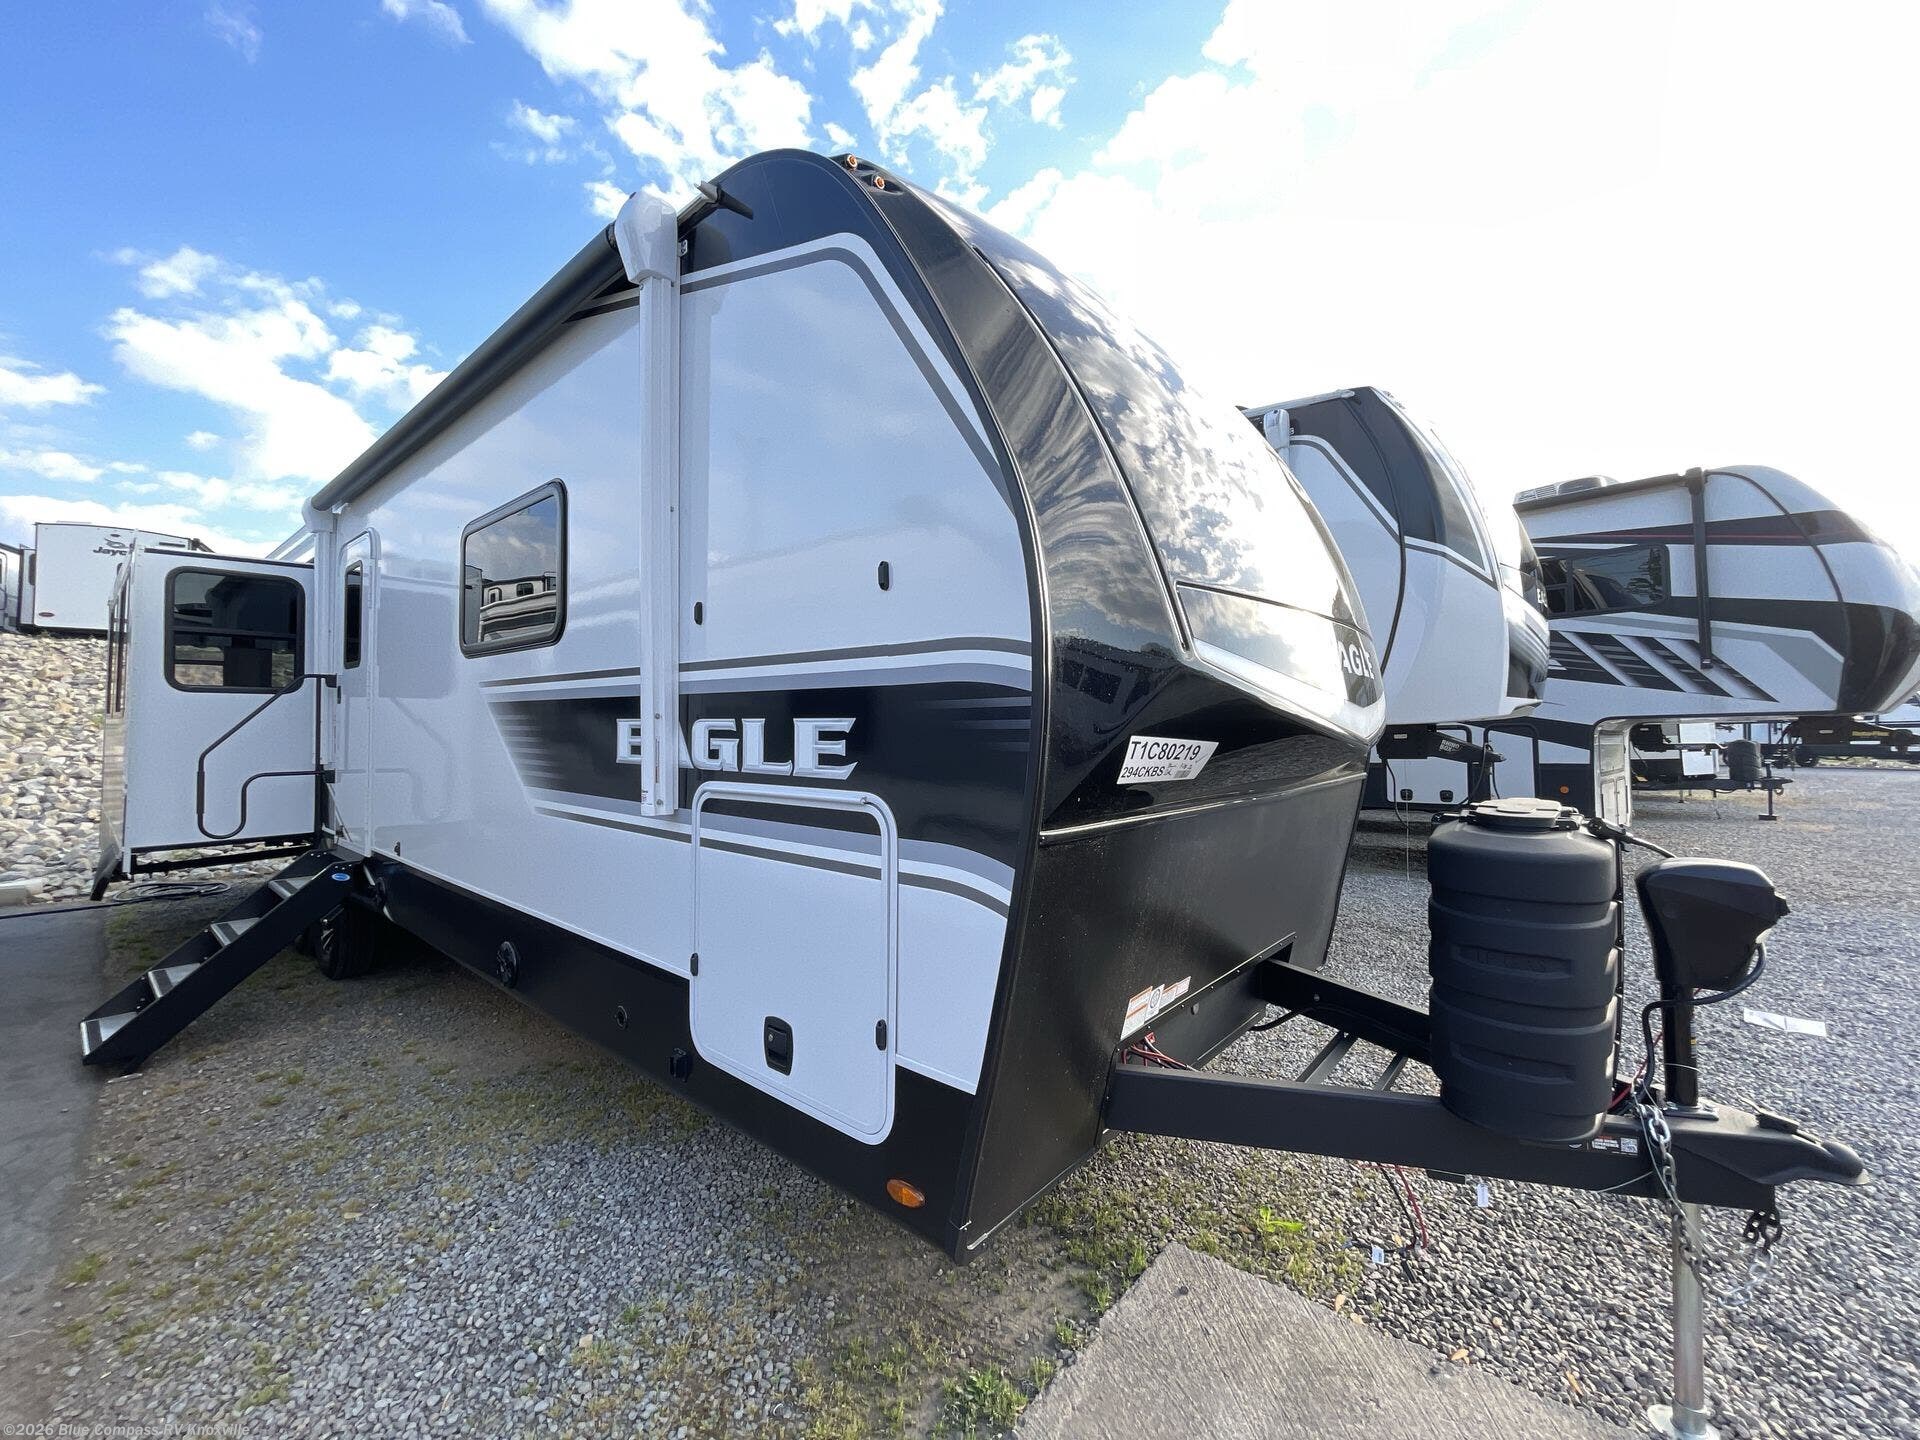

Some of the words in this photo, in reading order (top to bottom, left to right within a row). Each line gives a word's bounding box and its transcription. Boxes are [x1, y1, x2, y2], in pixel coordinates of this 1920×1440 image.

[92, 546, 128, 557] Jayc
[1130, 741, 1202, 761] T1C80219
[1121, 766, 1166, 779] 294CKBS
